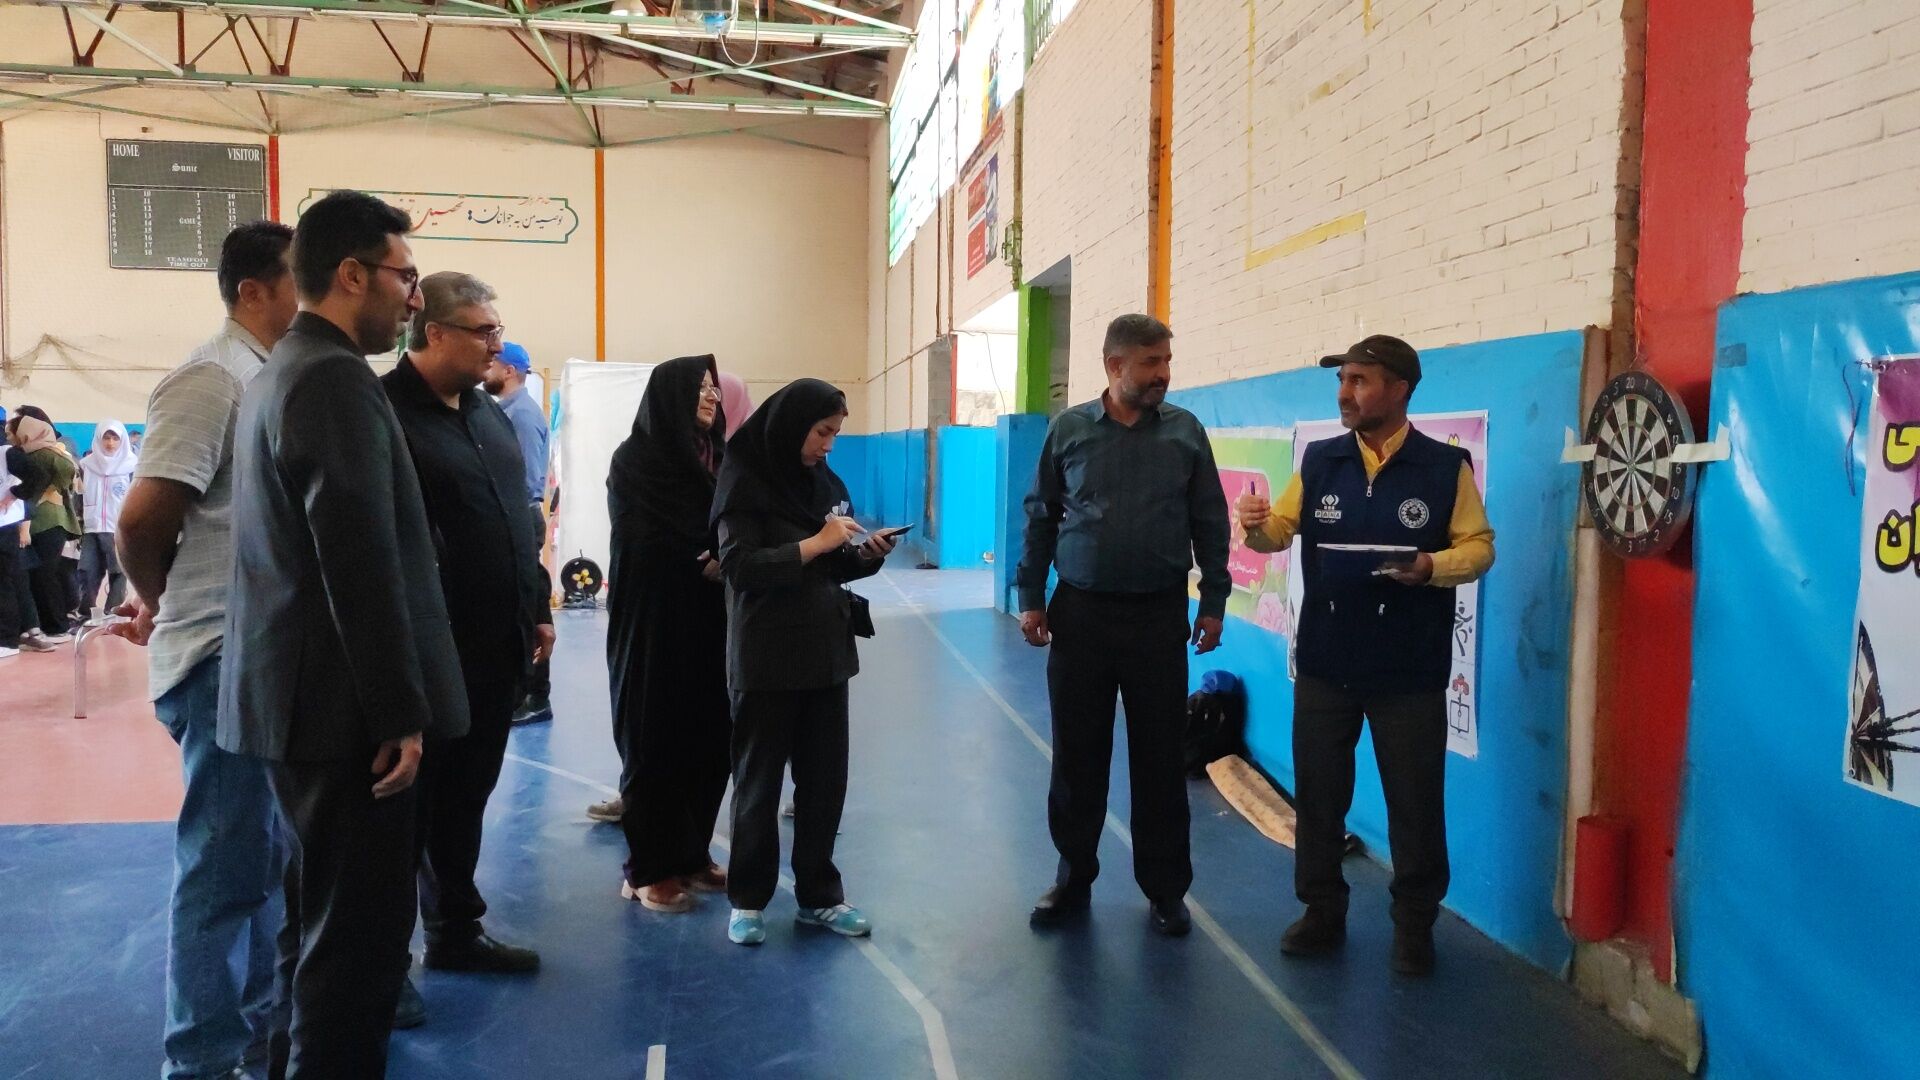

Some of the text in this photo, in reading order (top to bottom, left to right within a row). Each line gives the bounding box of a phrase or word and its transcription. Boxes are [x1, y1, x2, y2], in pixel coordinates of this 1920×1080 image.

[112, 143, 140, 157] HOME
[227, 147, 260, 161] VISITOR
[179, 217, 196, 225] GAME
[514, 220, 521, 228] به
[522, 214, 535, 229] من
[1626, 377, 1636, 389] 20
[1667, 413, 1674, 424] 4
[1675, 464, 1682, 474] 6
[1671, 486, 1680, 500] 10
[1663, 509, 1674, 525] 15
[1653, 529, 1660, 542] 2
[1627, 540, 1633, 553] 3
